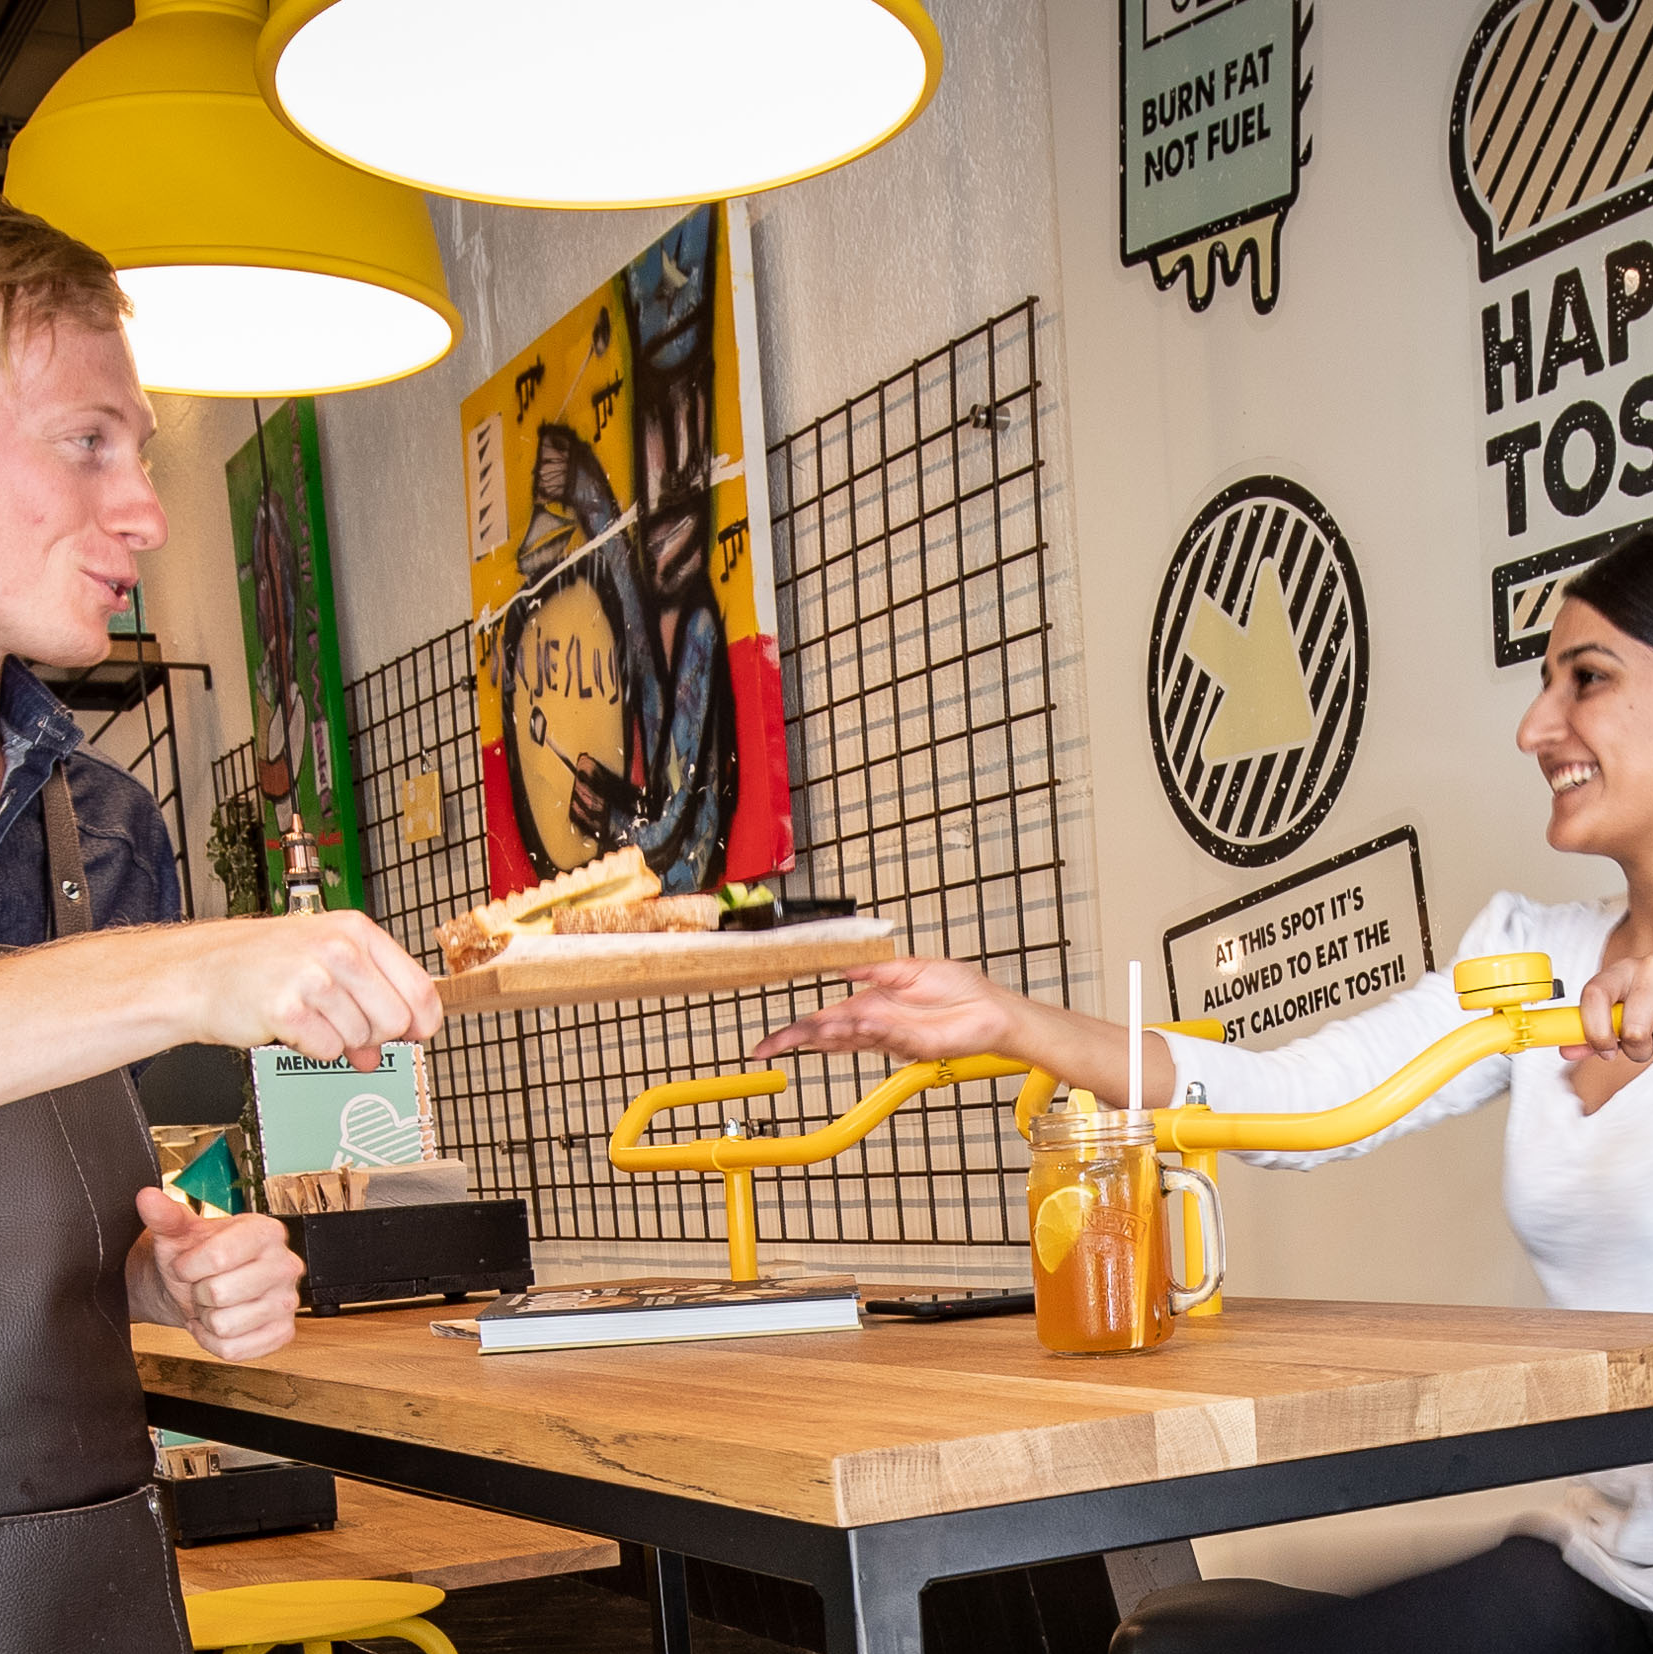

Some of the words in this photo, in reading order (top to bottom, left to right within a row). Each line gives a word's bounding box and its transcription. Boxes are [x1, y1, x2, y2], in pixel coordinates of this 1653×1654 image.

[1142, 69, 1215, 137] BURN
[1224, 42, 1274, 100] FAT
[1145, 131, 1199, 188] NOT
[1207, 102, 1271, 162] FUEL
[1203, 962, 1283, 1013] ALLOWED
[1286, 951, 1312, 979] TO
[1315, 935, 1349, 969] EAT
[1353, 919, 1391, 953] THE
[1215, 940, 1234, 967] AT
[1238, 922, 1277, 956] THIS
[1280, 901, 1325, 940] SPOT
[1330, 886, 1364, 921] IT'S
[1222, 1016, 1245, 1043] ST
[1250, 981, 1342, 1034] CALORIFIC
[1344, 954, 1406, 1000] TOSTI!
[276, 1053, 395, 1071] MENUKT
